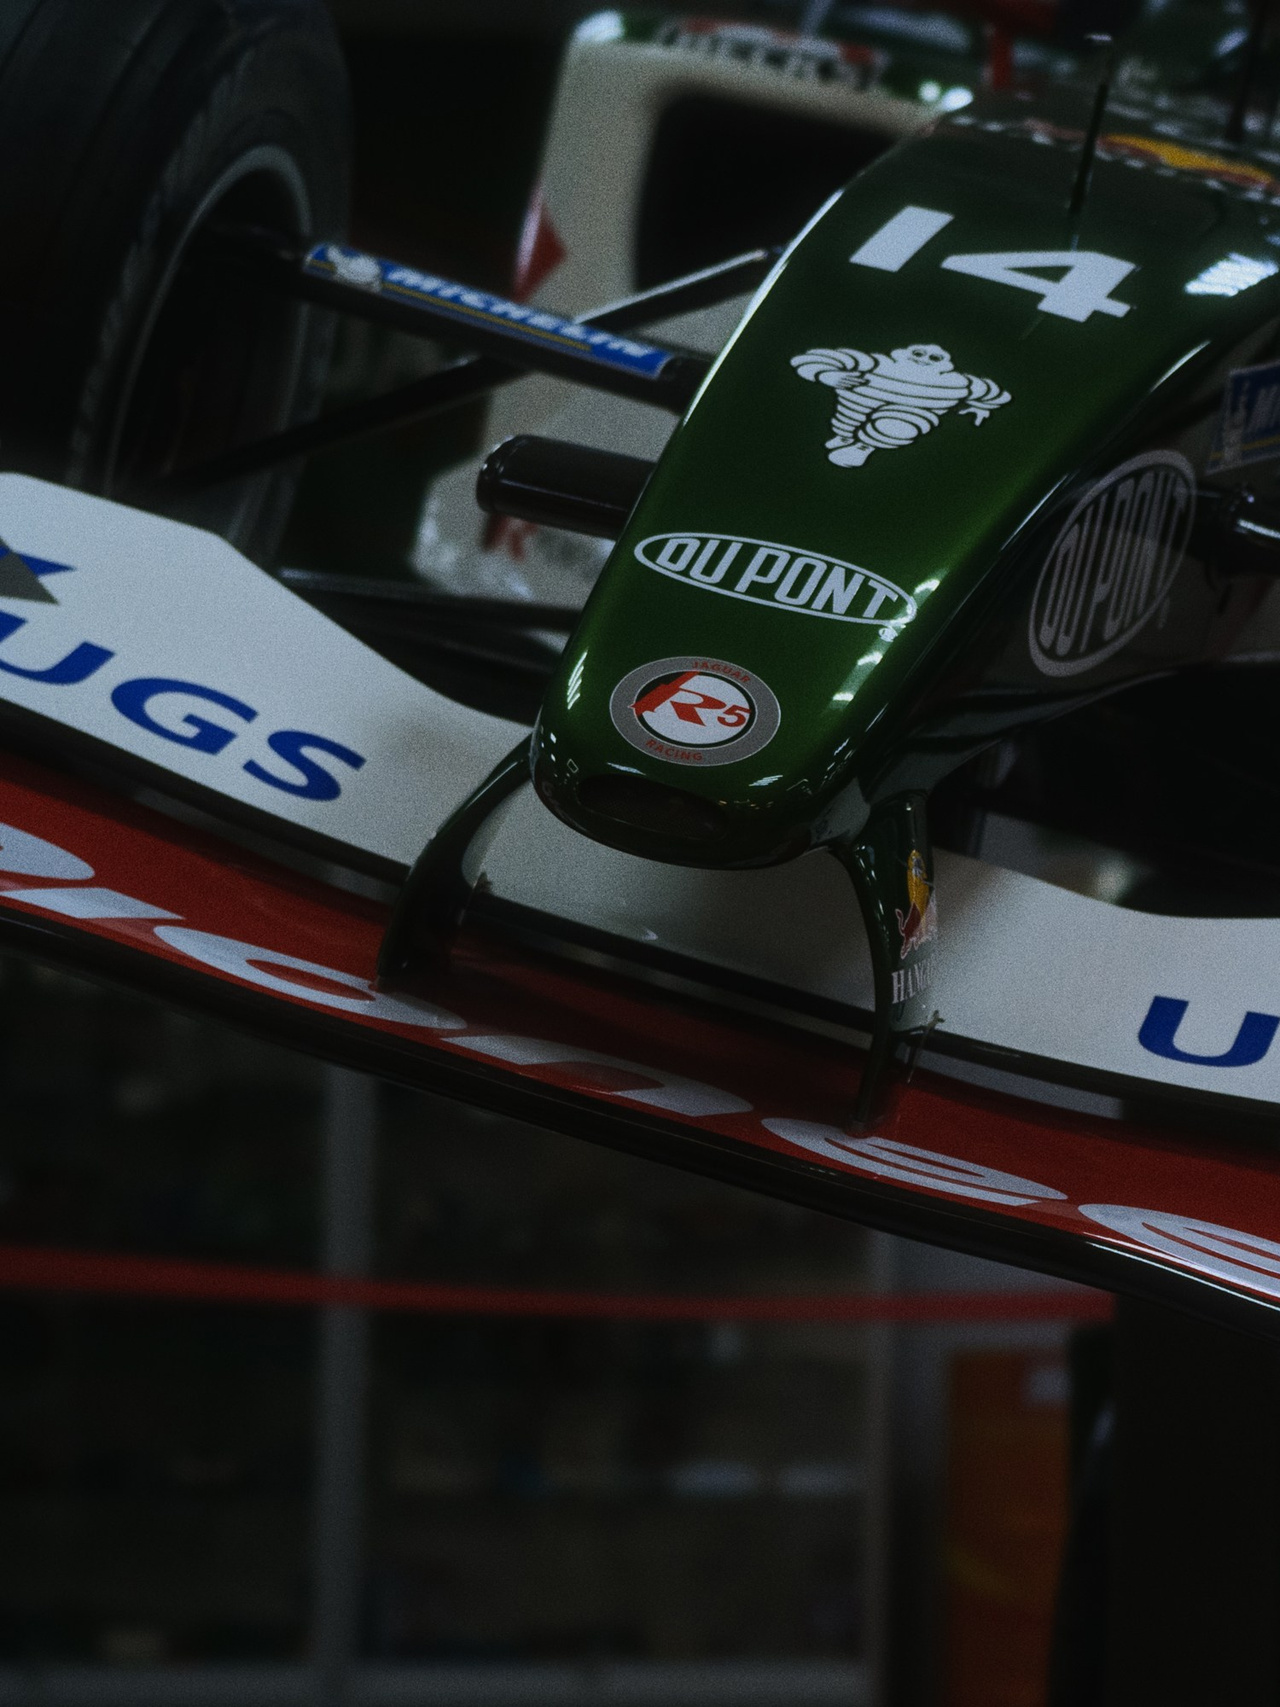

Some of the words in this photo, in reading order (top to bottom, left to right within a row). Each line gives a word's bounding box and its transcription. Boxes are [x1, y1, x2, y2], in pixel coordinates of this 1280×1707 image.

[849, 204, 1137, 322] 14
[691, 660, 751, 684] JAGUAR
[645, 739, 703, 761] RACING
